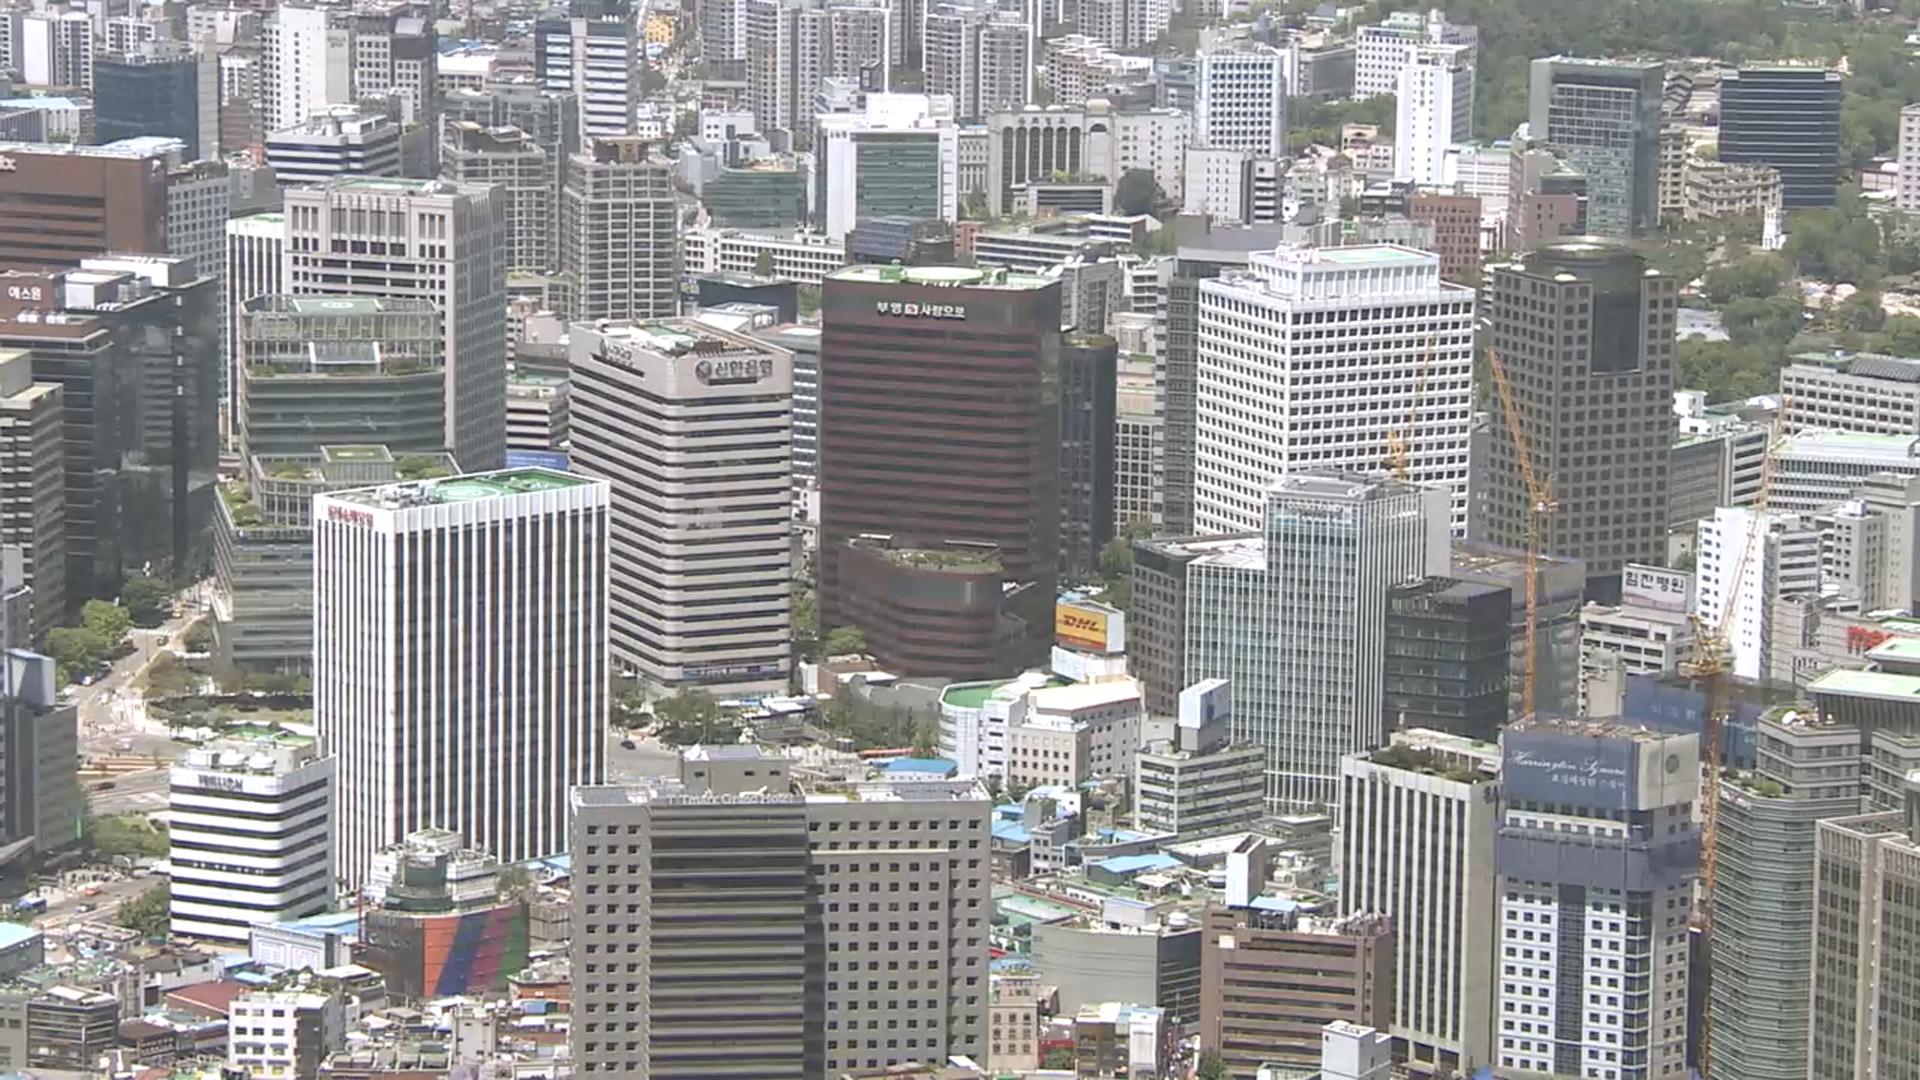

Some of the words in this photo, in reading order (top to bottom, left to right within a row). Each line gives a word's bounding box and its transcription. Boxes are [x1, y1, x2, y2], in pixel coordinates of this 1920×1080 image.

[8, 286, 42, 301] 에스원
[876, 301, 902, 315] 부영
[919, 303, 965, 318] 사랑으로
[714, 359, 773, 378] 신한은행
[1063, 614, 1099, 631] DHL
